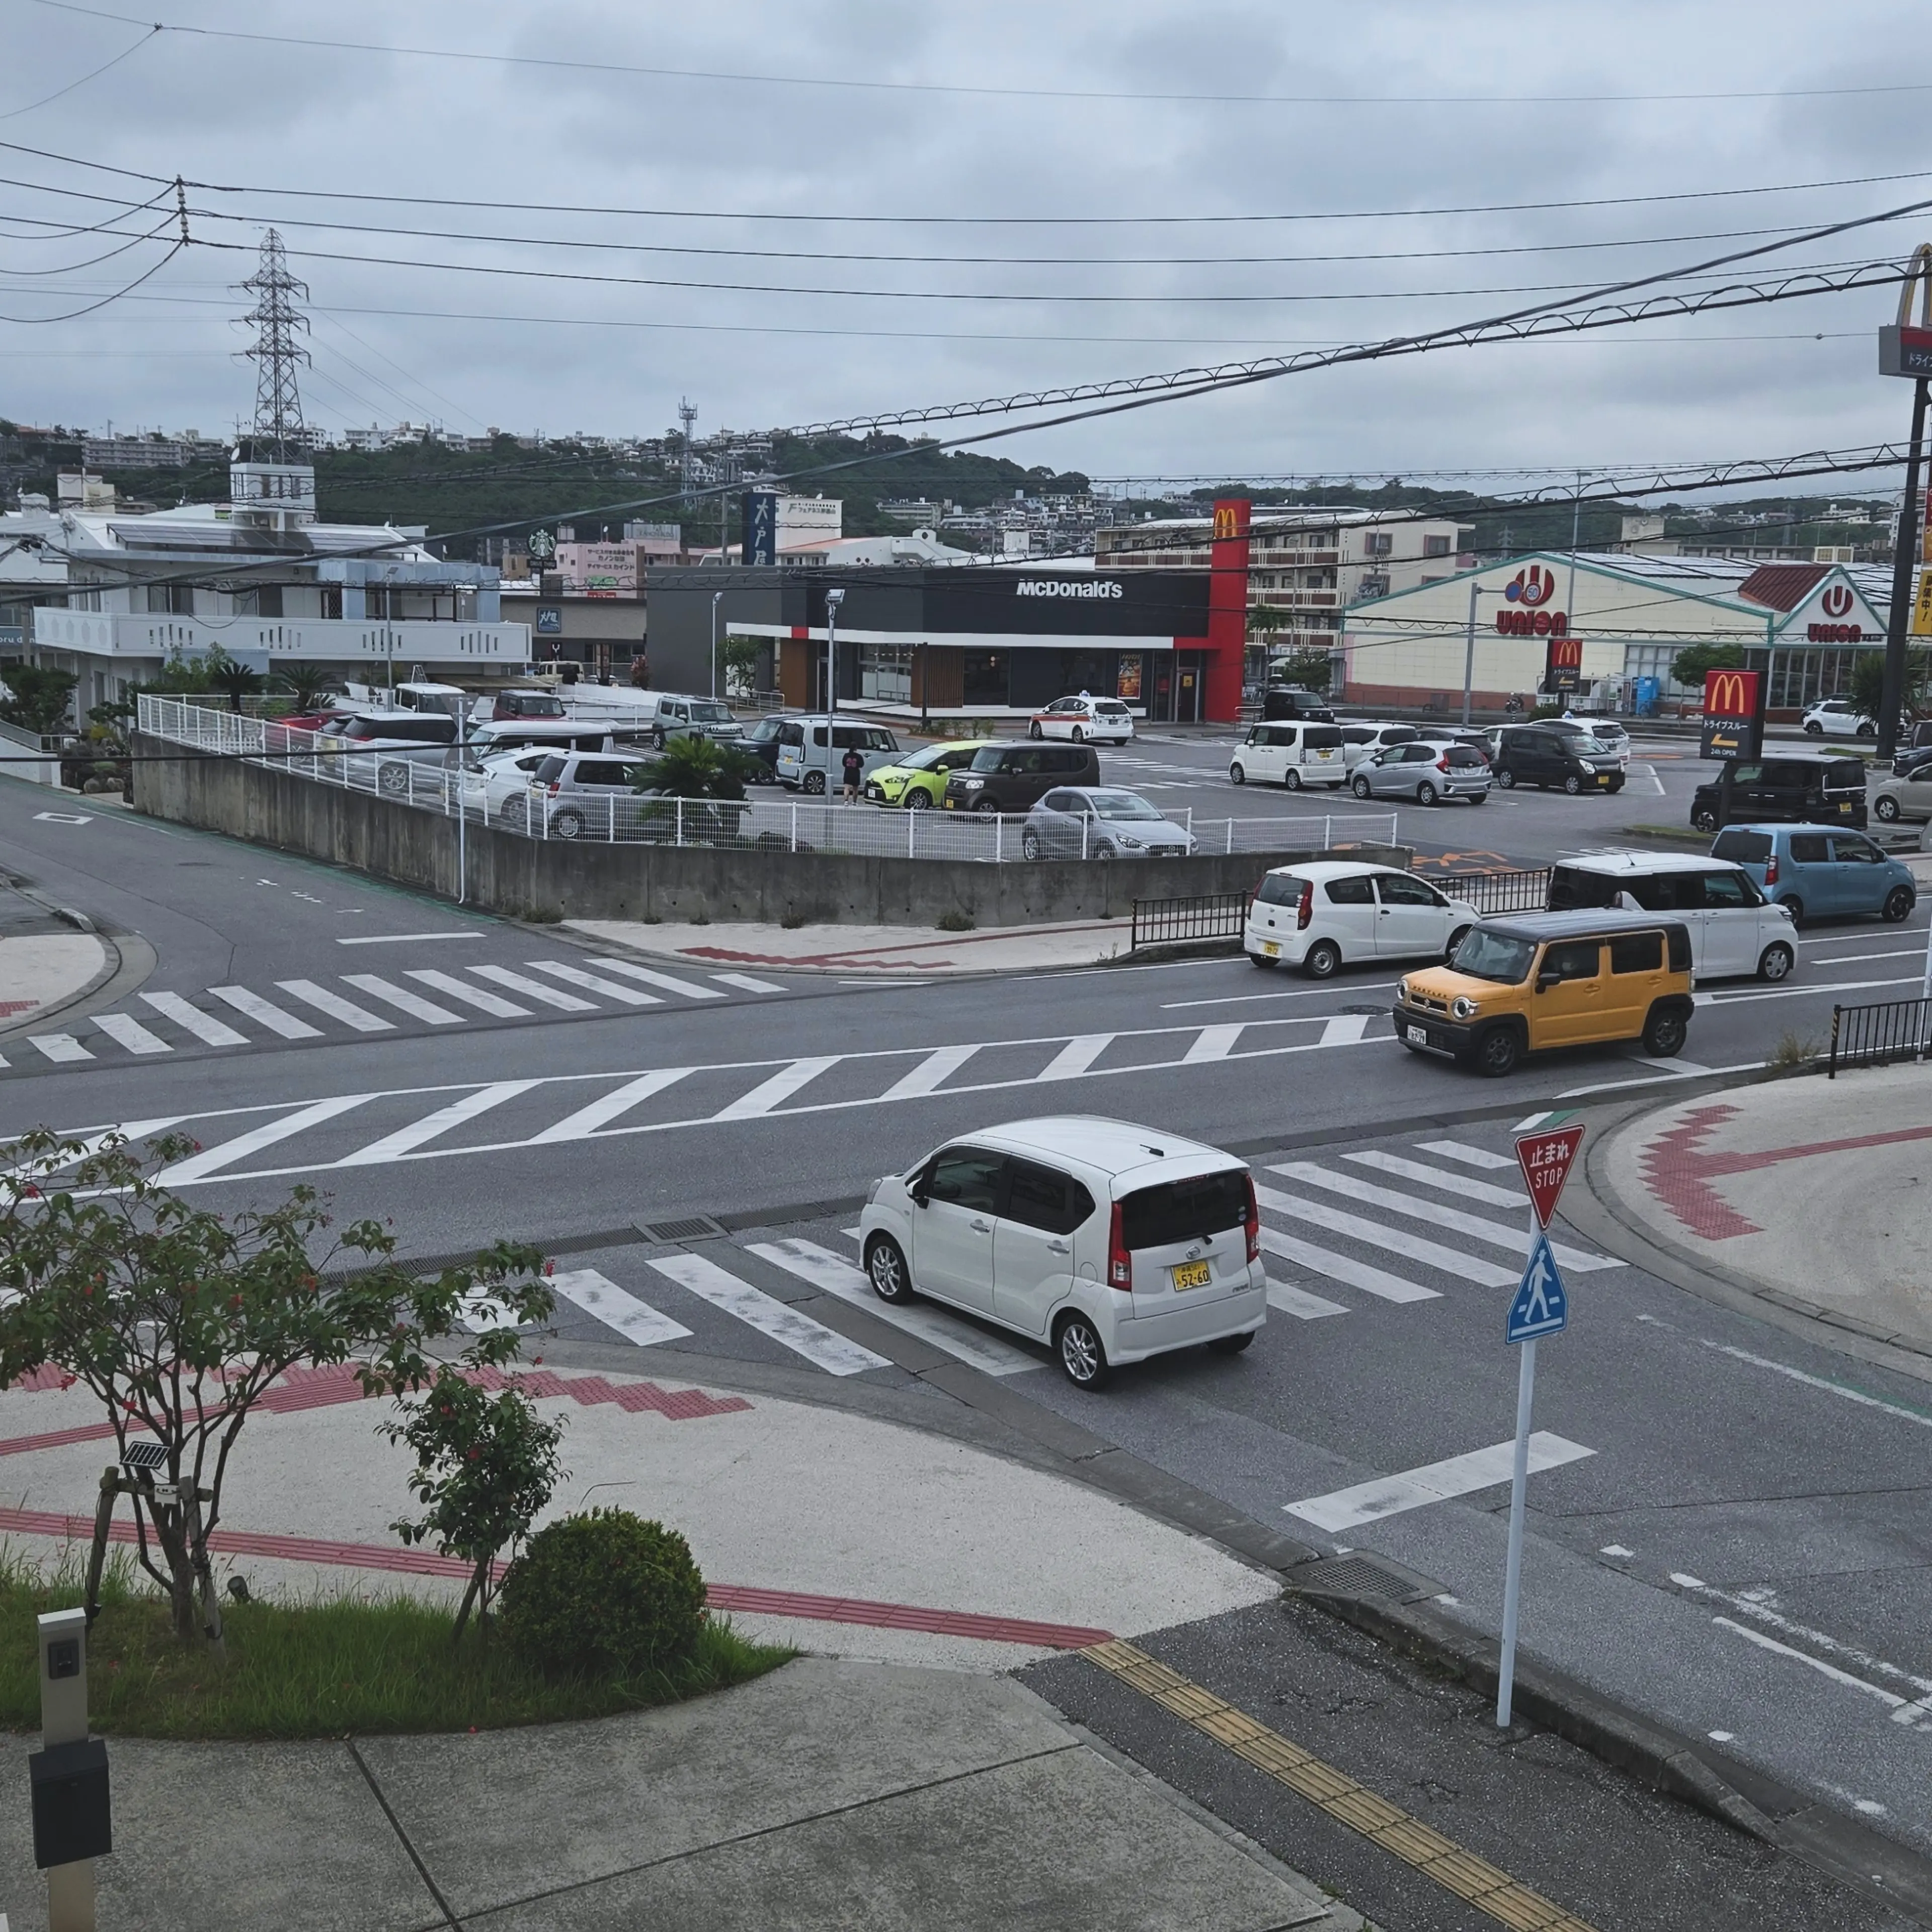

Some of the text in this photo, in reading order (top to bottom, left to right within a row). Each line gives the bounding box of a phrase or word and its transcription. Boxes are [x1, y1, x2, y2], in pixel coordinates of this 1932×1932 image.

[754, 497, 769, 566] 大戸屋
[1016, 579, 1123, 599] McDonald's
[1527, 587, 1539, 598] 50
[17, 635, 35, 643] dn
[1704, 719, 1748, 730] ドライブスルー
[1721, 748, 1736, 756] OPEN
[1530, 1140, 1569, 1168] 止まれ
[1536, 1167, 1563, 1189] STOP
[1181, 1269, 1209, 1287] 52-60
